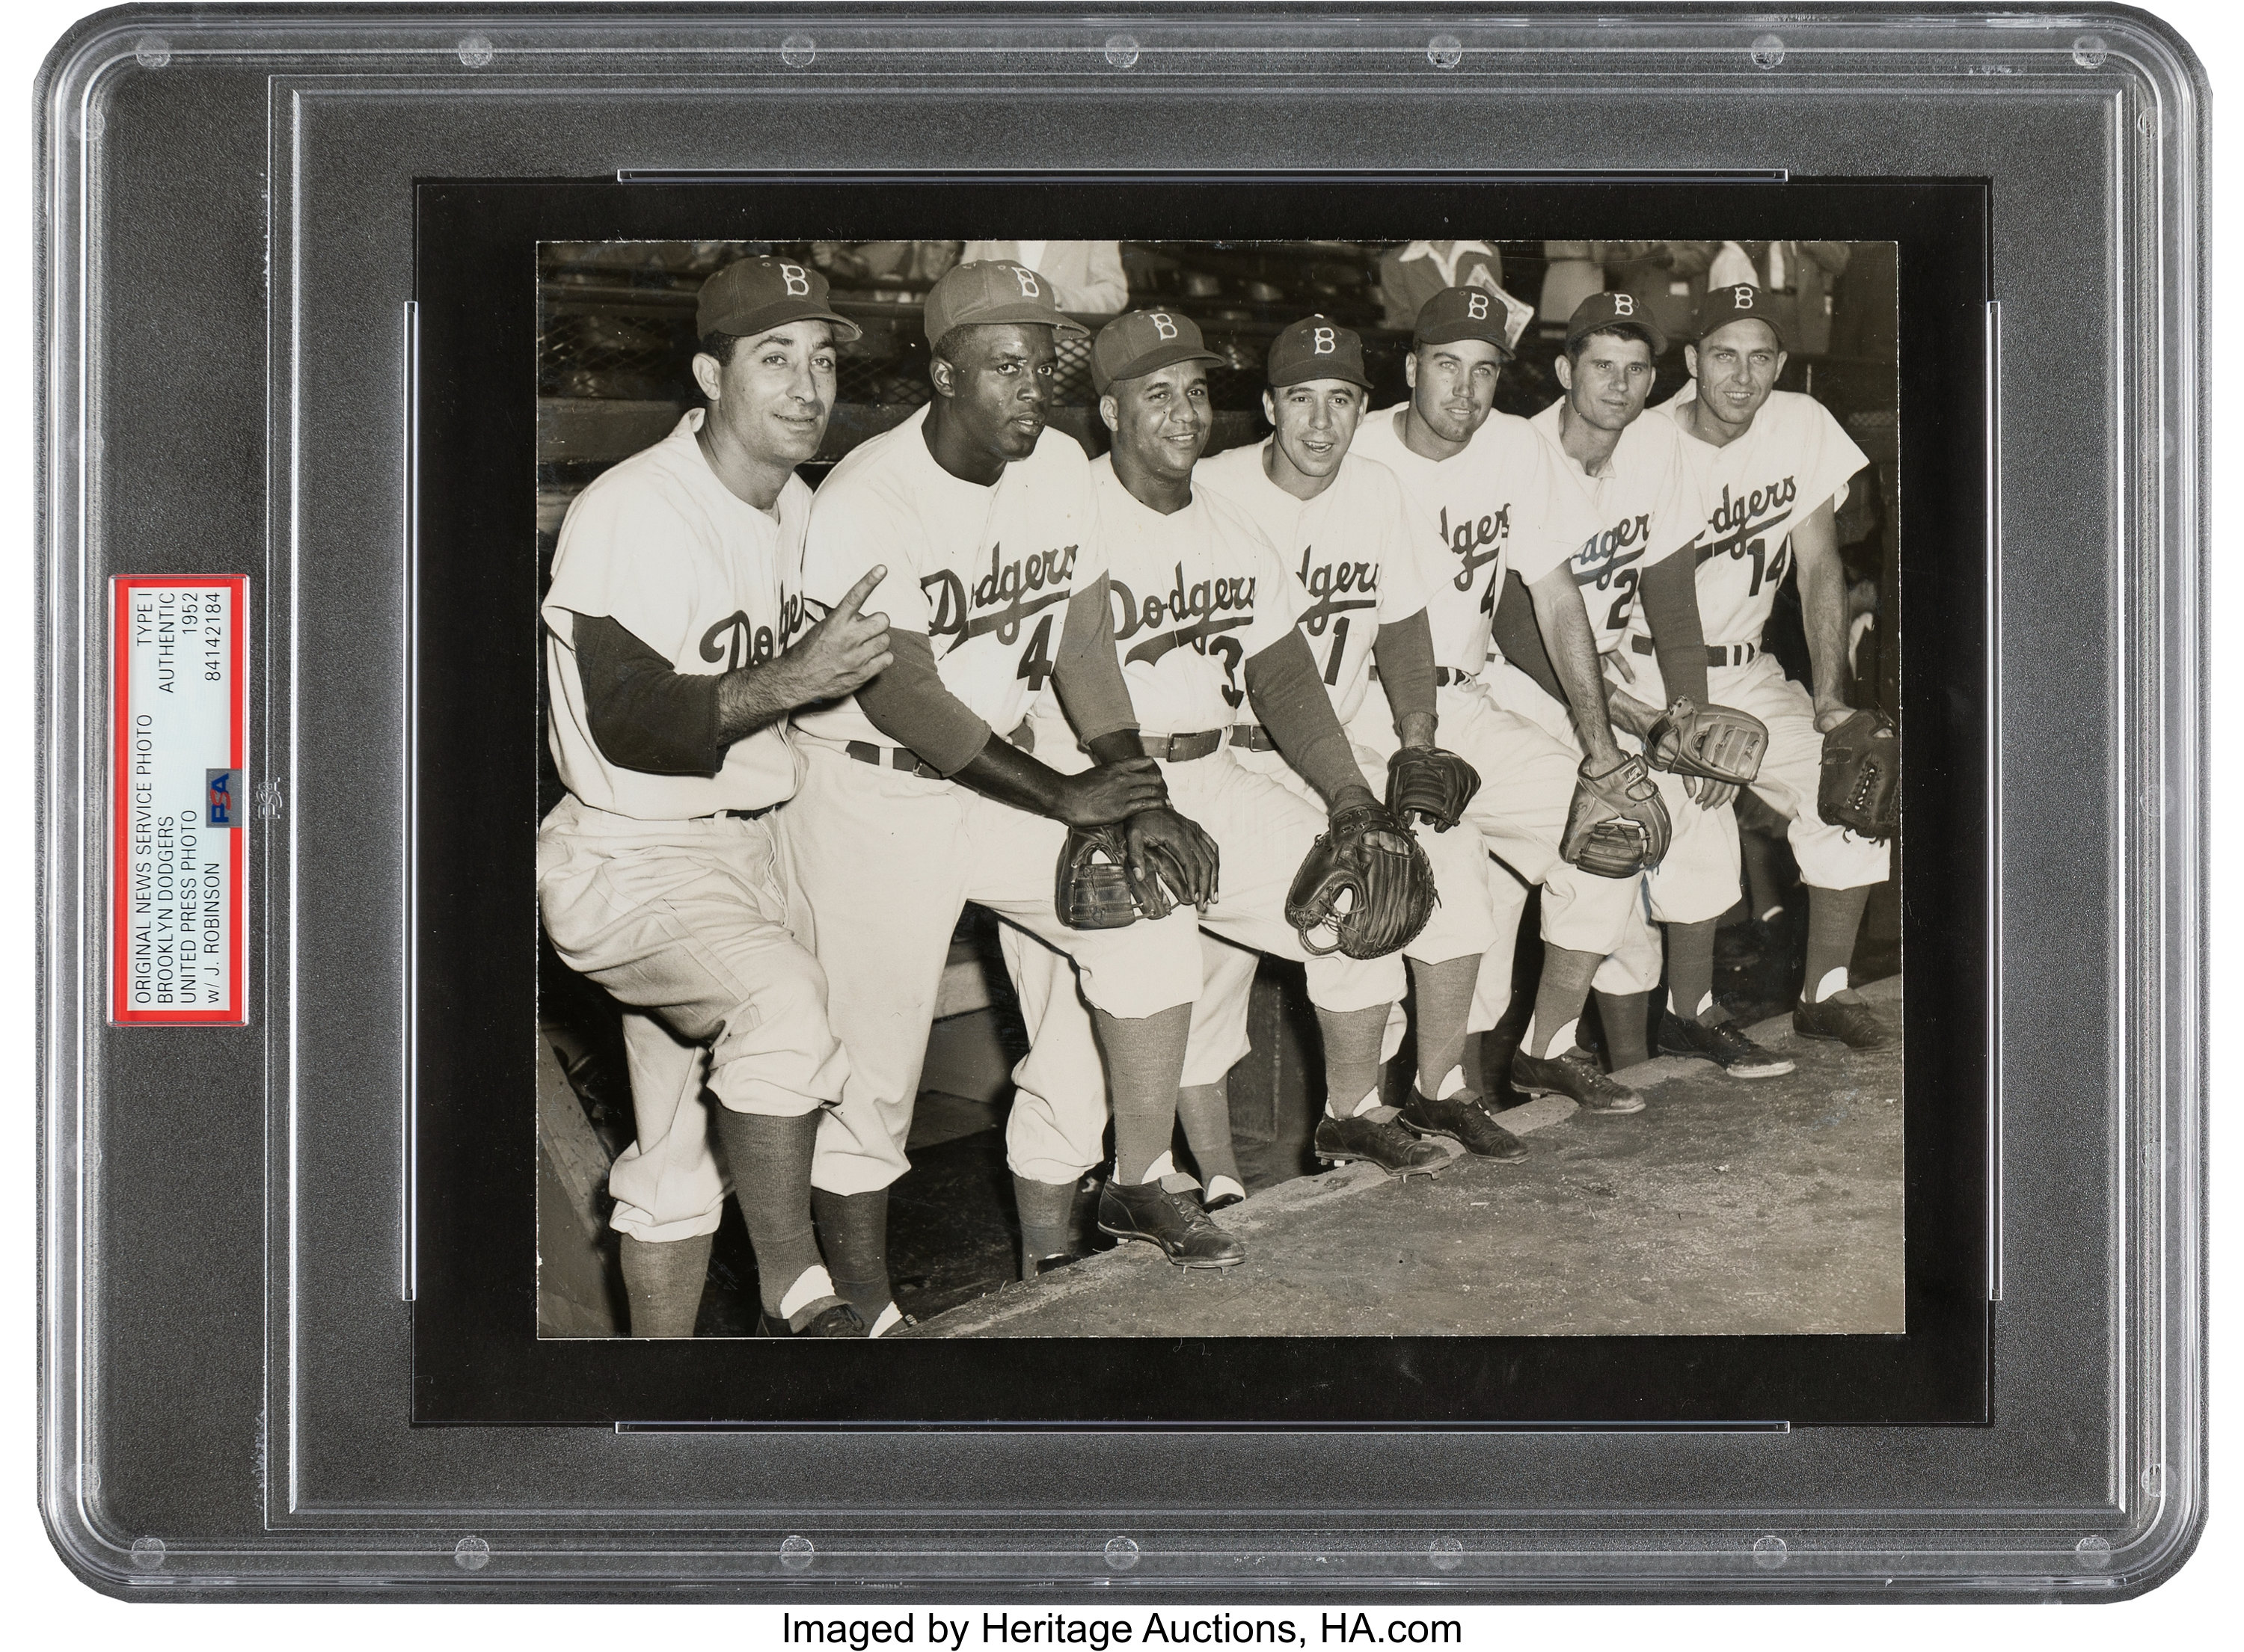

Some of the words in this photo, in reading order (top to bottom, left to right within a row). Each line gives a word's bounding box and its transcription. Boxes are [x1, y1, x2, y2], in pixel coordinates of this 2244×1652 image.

[782, 265, 809, 297] B
[1012, 266, 1040, 298] B
[1467, 292, 1489, 321] B
[1614, 292, 1634, 316] B
[1734, 286, 1753, 309] B
[1150, 313, 1178, 340] B
[1313, 327, 1336, 355] B
[1693, 476, 1797, 561] dgers
[919, 541, 1079, 646] Ddgers
[1747, 533, 1788, 597] 14
[137, 604, 153, 647] TYPE
[181, 592, 198, 635] 1952
[699, 580, 804, 670] Dodge
[1606, 568, 1640, 630] 2
[159, 593, 175, 693] AUTHENTIC
[204, 592, 221, 681] 84142184
[1017, 614, 1053, 691] 4
[1323, 615, 1351, 687] 1
[1209, 635, 1244, 710] 3
[136, 714, 153, 775] PHOTO
[135, 783, 152, 855] SERVICE
[210, 773, 231, 823] PSA
[157, 816, 174, 900] DODGERS
[180, 810, 197, 870] PHOTO
[135, 862, 152, 913] NEWS
[180, 878, 197, 932] PRESS
[203, 863, 221, 954] ROBINSON
[135, 921, 151, 1004] ORIGINAL
[157, 909, 174, 1004] BROOKLYN
[180, 939, 197, 1004] UNITED
[203, 962, 220, 976] J.
